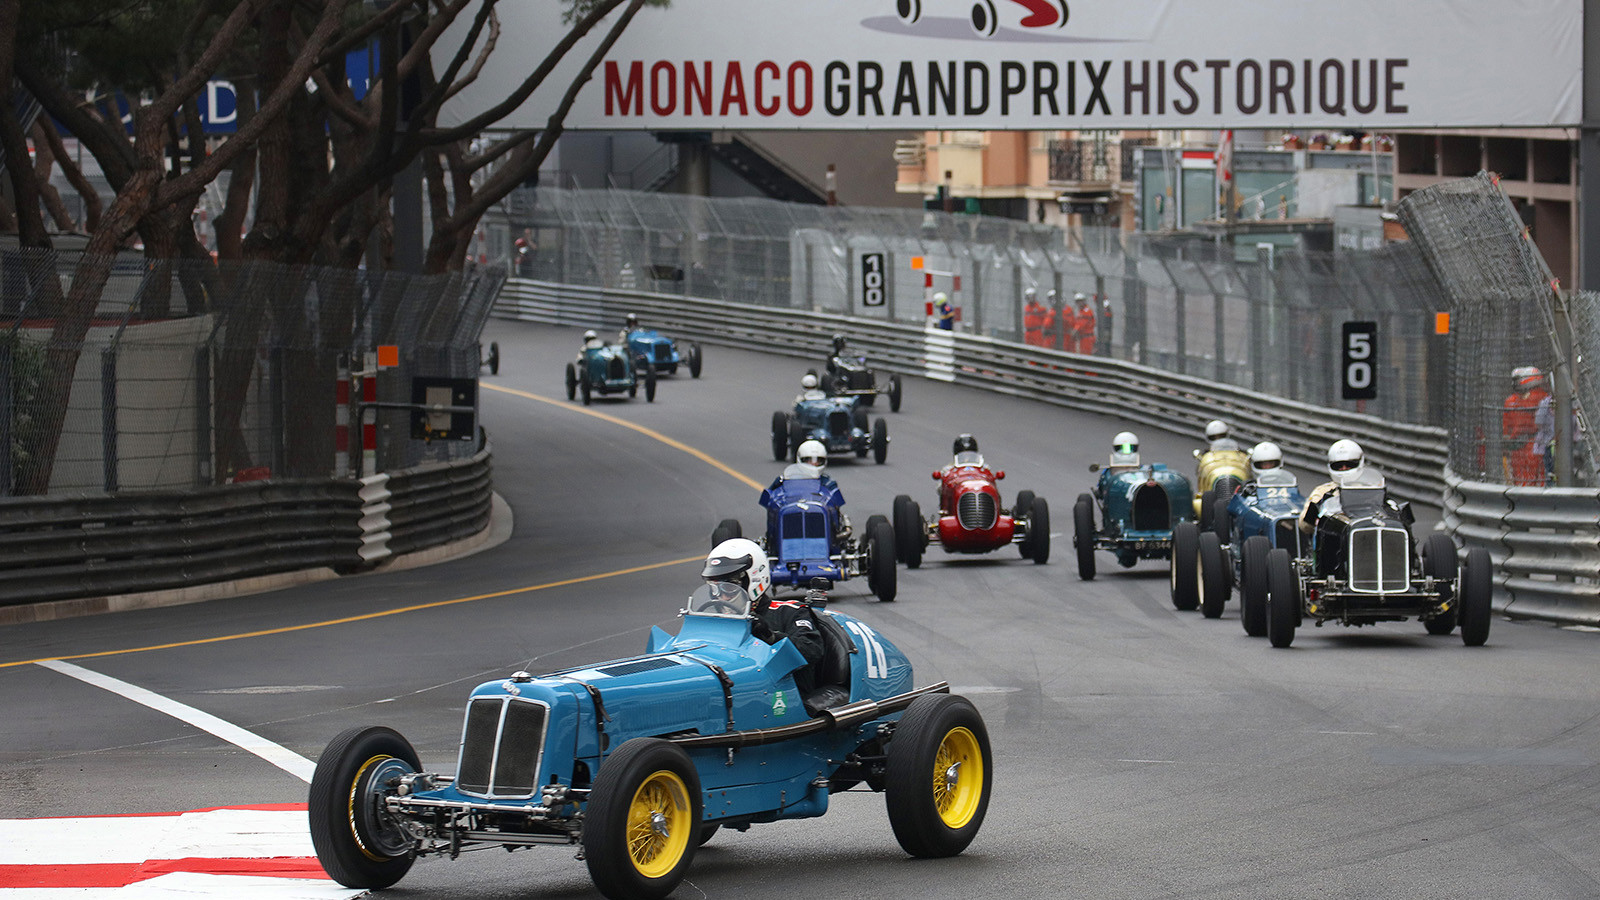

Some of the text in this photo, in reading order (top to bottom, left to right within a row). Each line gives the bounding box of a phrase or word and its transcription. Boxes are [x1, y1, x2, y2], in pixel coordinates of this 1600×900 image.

[604, 58, 1409, 118] MONACO GRAND PRIX HISTORIQUE
[865, 255, 882, 305] 100
[1347, 333, 1372, 388] 50
[1266, 487, 1291, 498] 24
[845, 621, 888, 679] 26
